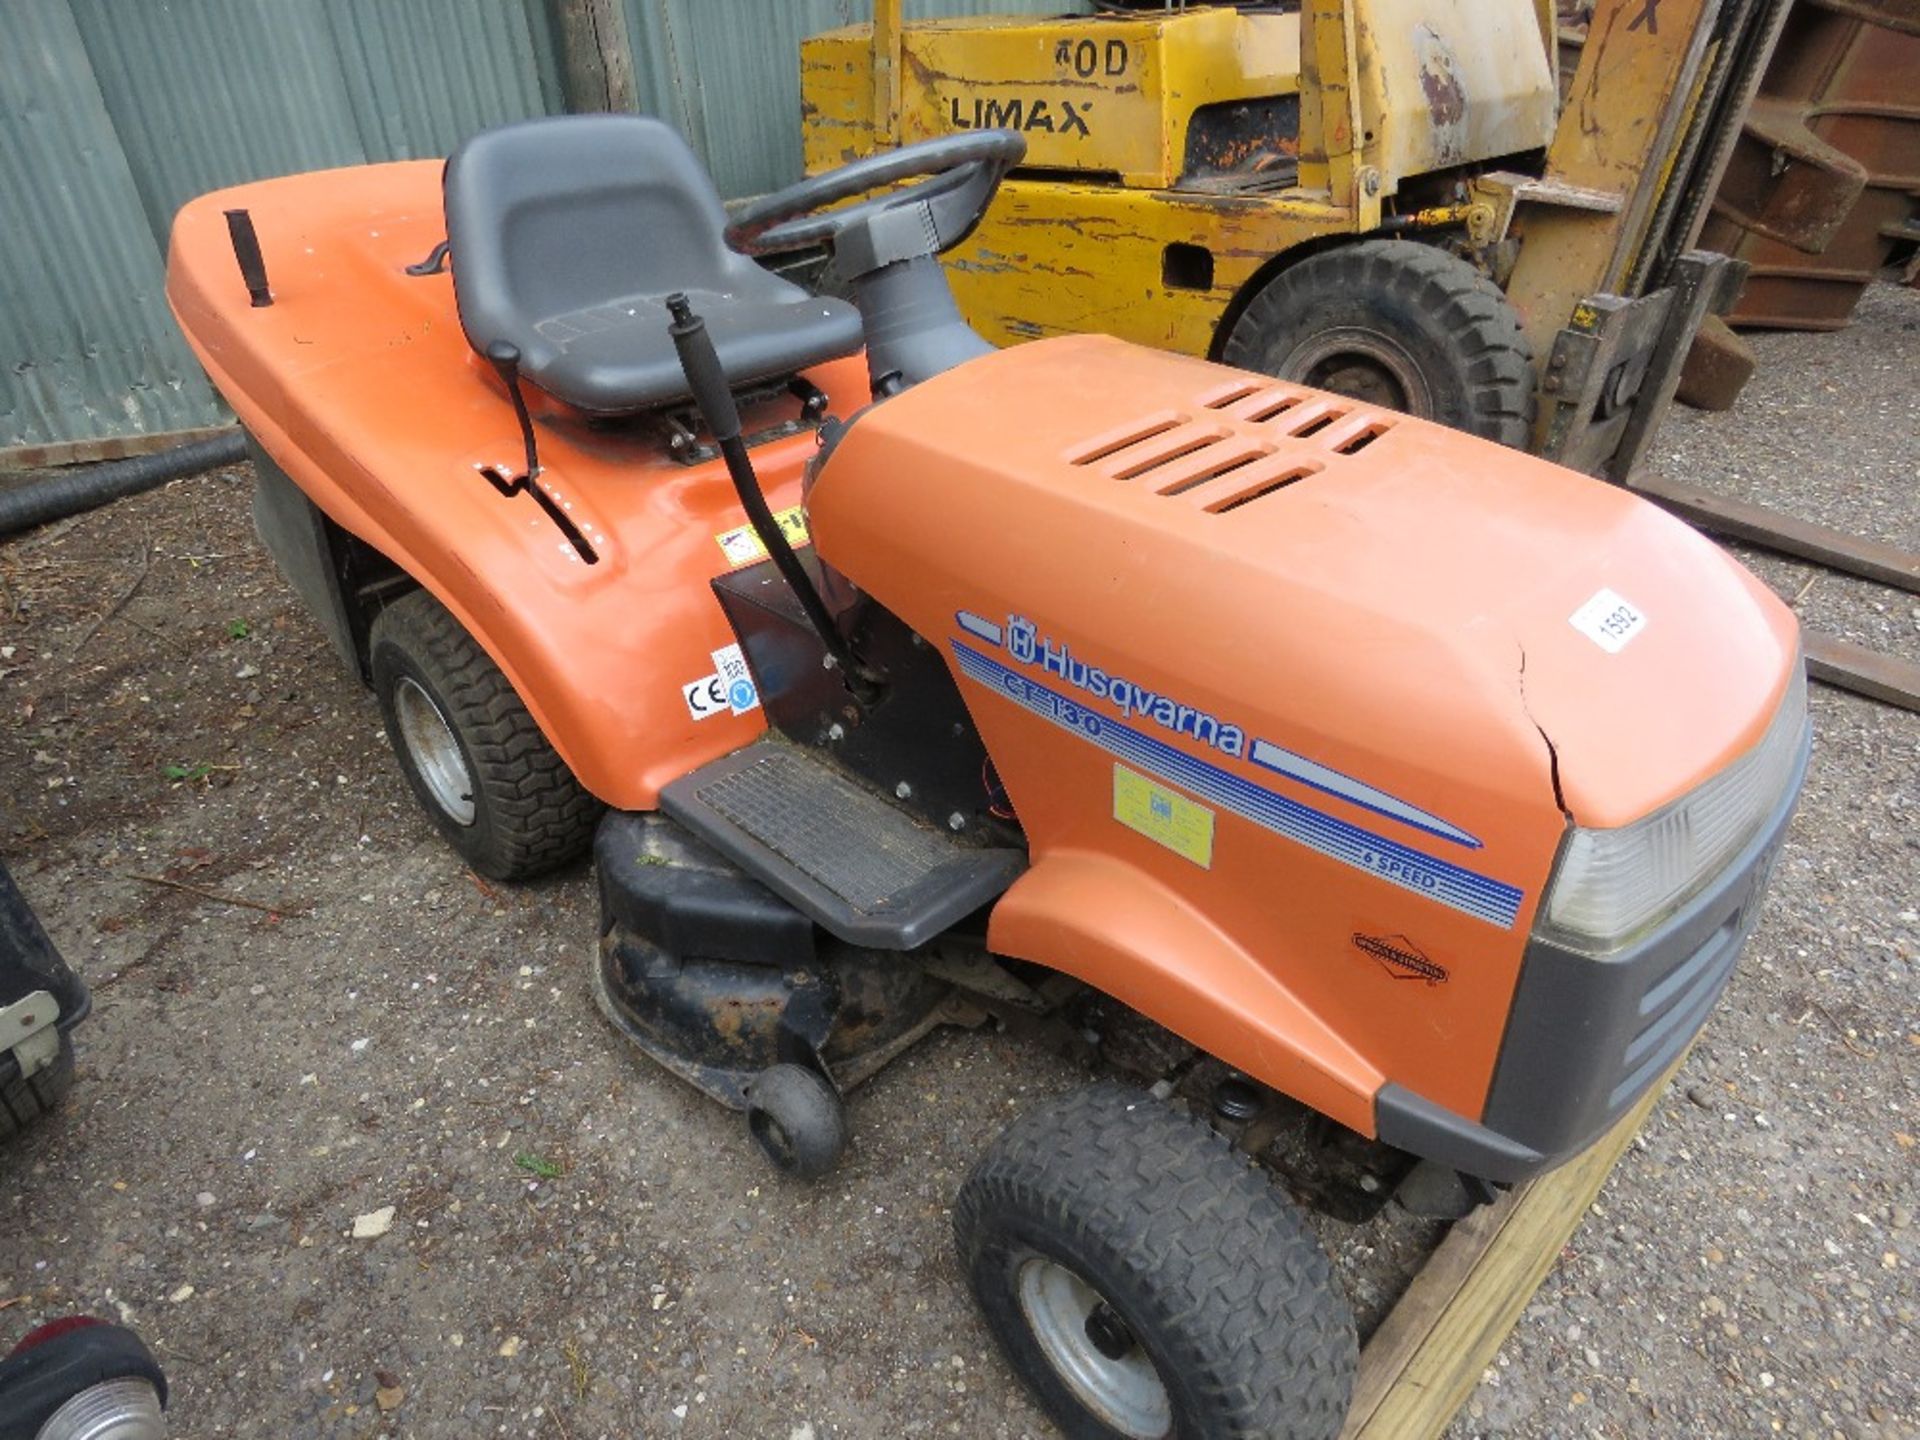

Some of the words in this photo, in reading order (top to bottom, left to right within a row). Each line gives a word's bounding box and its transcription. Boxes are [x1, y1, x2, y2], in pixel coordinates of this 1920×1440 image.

[1600, 605, 1638, 640] 1592
[1042, 636, 1245, 759] Husqvarna
[1052, 698, 1102, 736] 130
[1363, 852, 1373, 864] 6
[1377, 856, 1436, 888] SPEED
